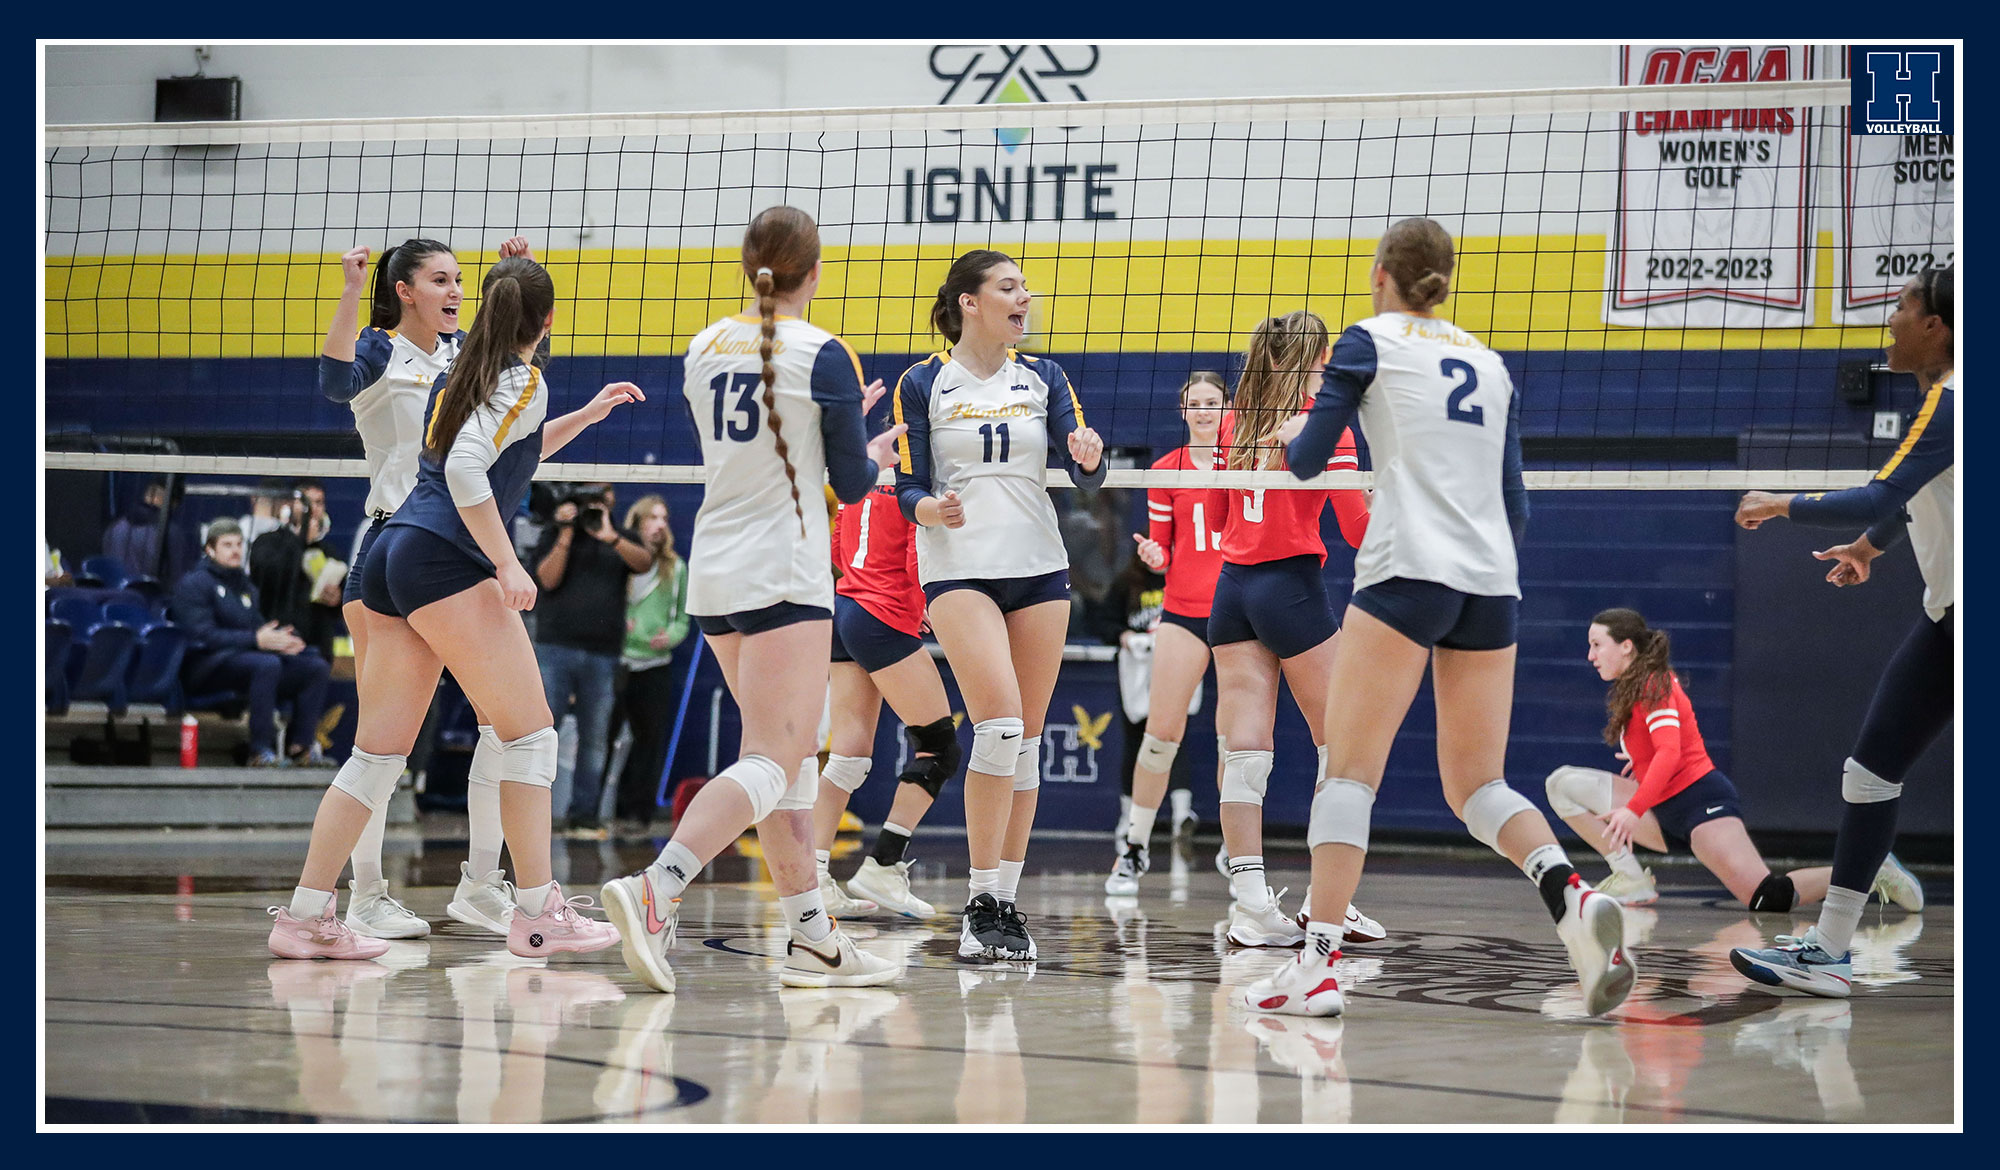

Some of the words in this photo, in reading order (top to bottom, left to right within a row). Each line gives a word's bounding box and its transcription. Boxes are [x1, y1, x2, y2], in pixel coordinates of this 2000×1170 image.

[1635, 107, 1795, 137] CHAMPIONS
[1659, 139, 1771, 163] WOMEN'S
[904, 164, 1118, 224] IGNITE
[1685, 166, 1743, 189] GOLF
[1647, 257, 1773, 280] 2022-2023
[709, 371, 764, 443] 13
[1440, 357, 1485, 427] 2
[978, 422, 1010, 463] 11
